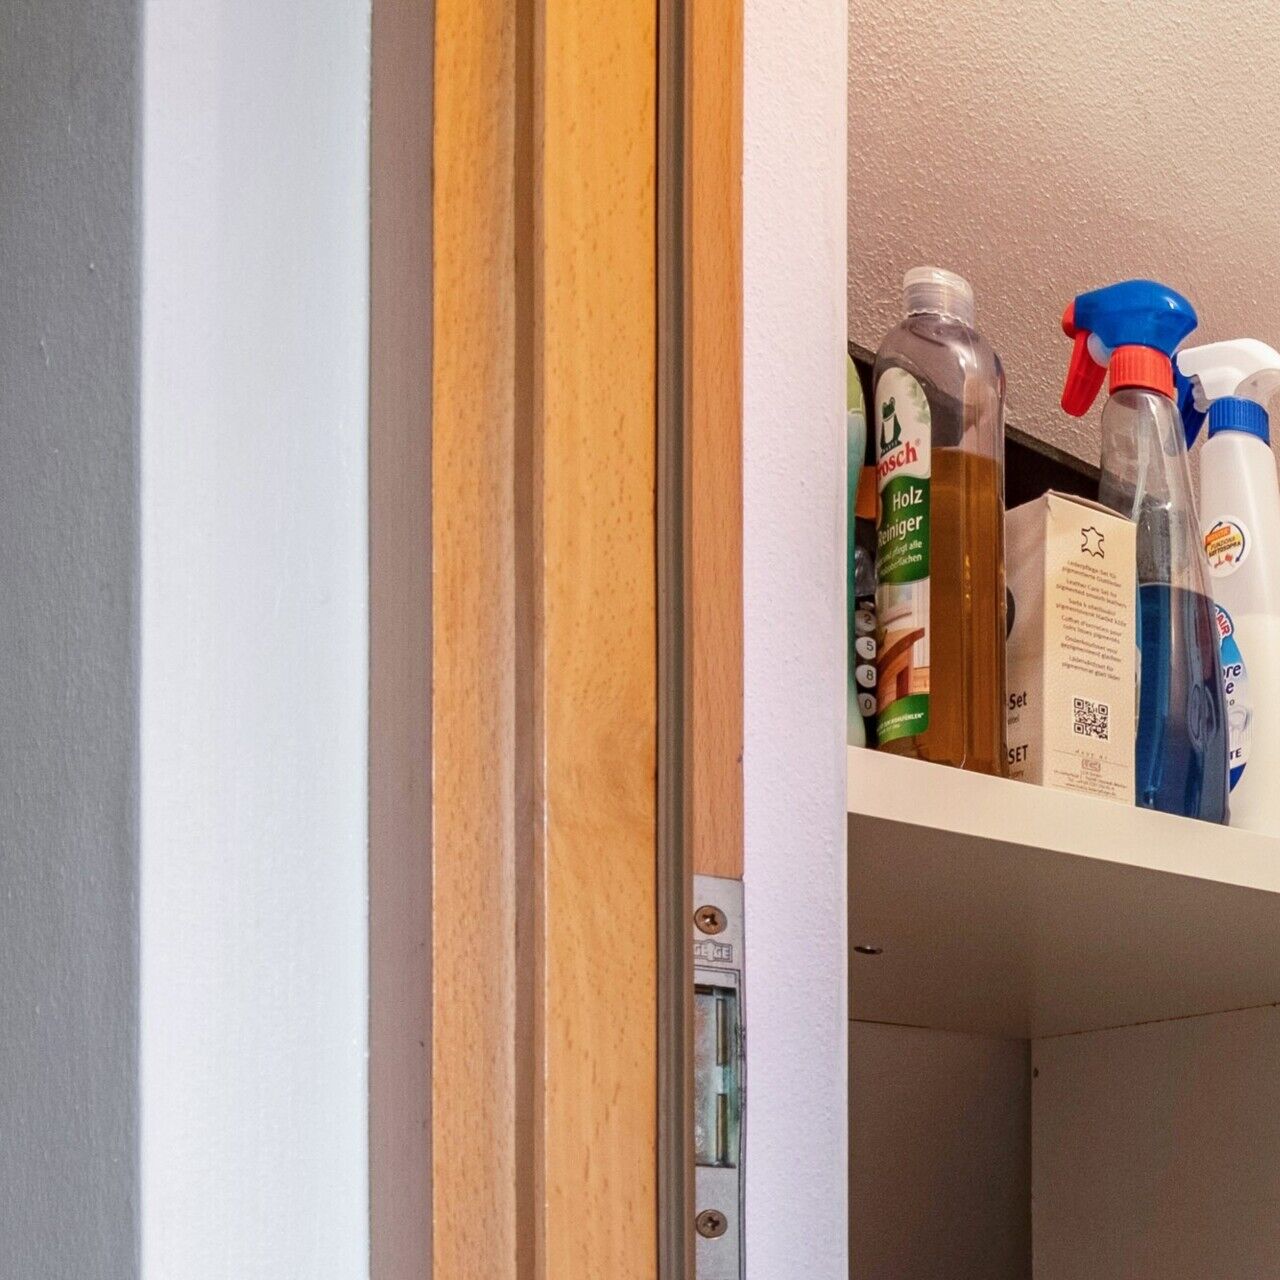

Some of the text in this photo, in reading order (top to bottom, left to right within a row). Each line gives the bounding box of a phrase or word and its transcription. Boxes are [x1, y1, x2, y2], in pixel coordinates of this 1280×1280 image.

[893, 486, 923, 513] Holz
[878, 516, 923, 548] Reiniger
[863, 613, 872, 625] 2
[866, 641, 873, 652] 5
[866, 669, 873, 681] 8
[1009, 691, 1027, 710] Set
[1009, 744, 1028, 765] SET
